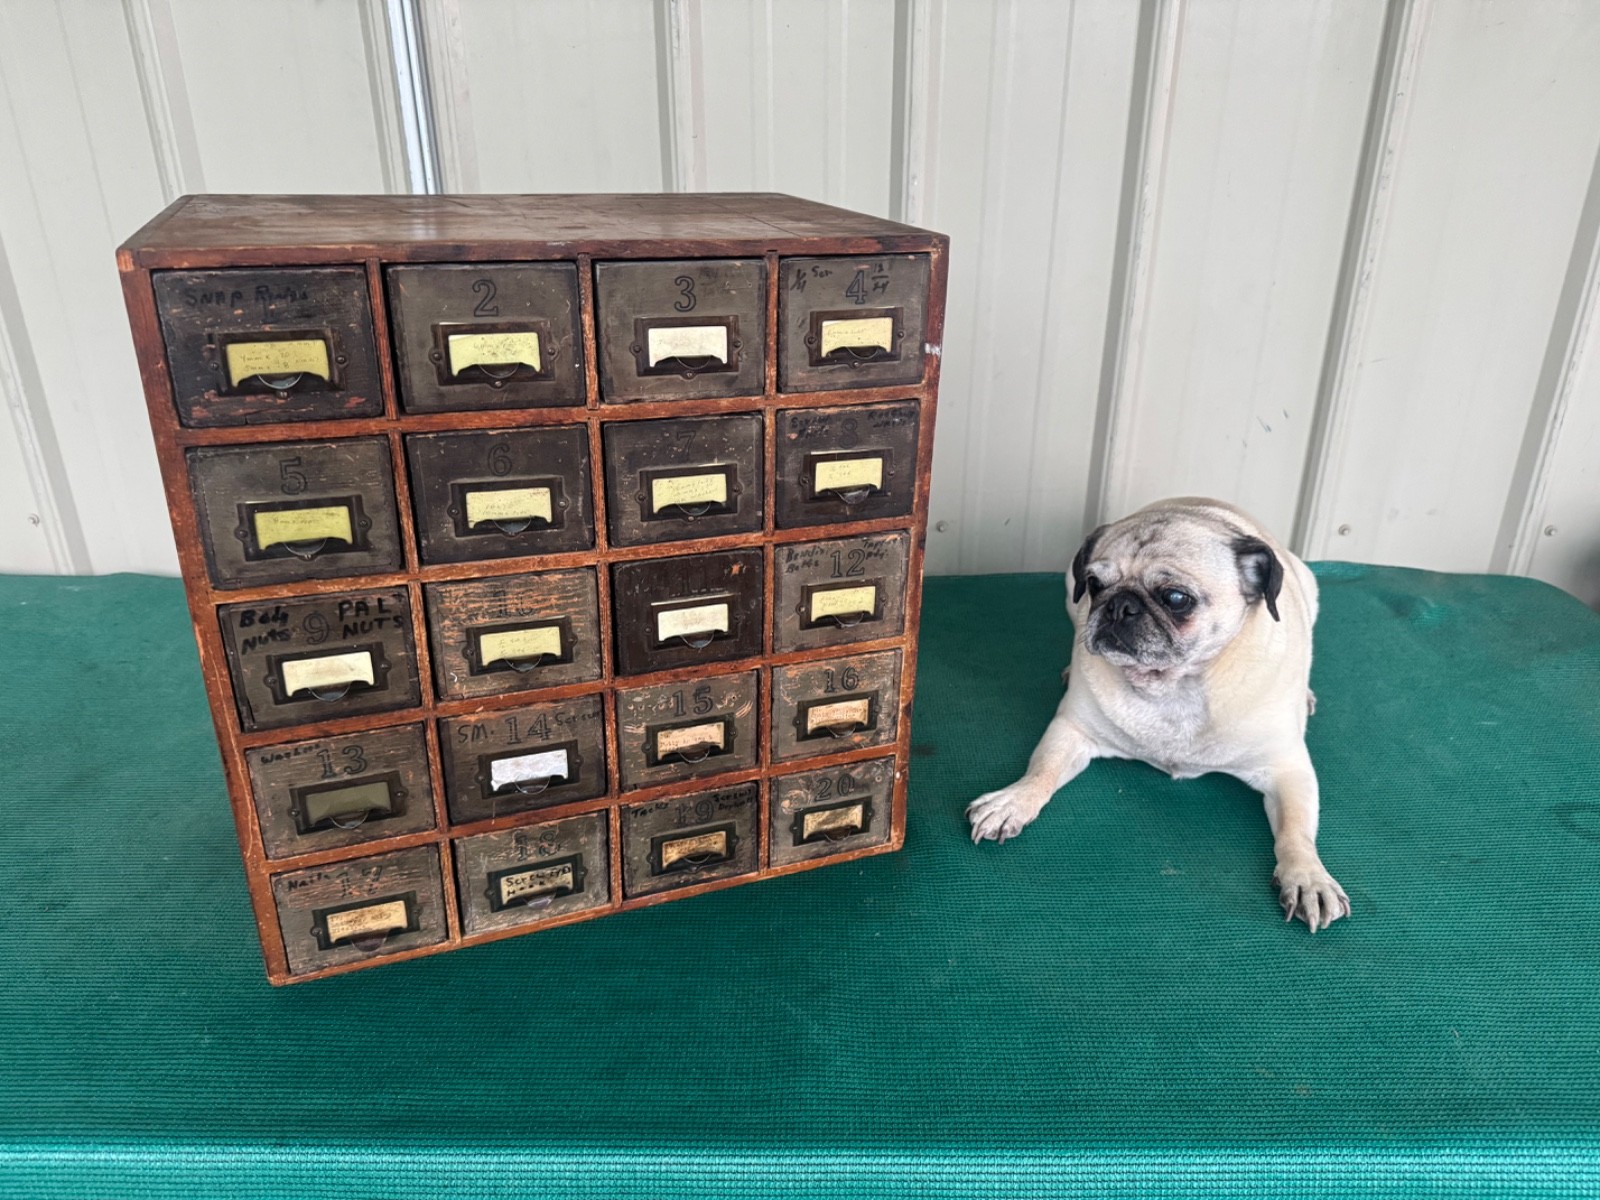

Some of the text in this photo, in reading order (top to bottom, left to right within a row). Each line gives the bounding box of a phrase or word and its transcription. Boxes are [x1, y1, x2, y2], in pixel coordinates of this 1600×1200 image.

[472, 279, 499, 318] 2
[674, 275, 697, 312] 3
[845, 269, 869, 305] 4
[677, 429, 697, 462] 7
[838, 417, 859, 450] 8
[279, 456, 308, 496] 5
[487, 443, 513, 477] 6
[830, 548, 866, 578] 12
[302, 611, 330, 646] 9
[342, 614, 406, 640] NUTS
[823, 666, 861, 694] 16
[673, 686, 714, 717] 15
[505, 713, 552, 745] 14
[317, 744, 369, 779] 13
[814, 773, 855, 803] 20
